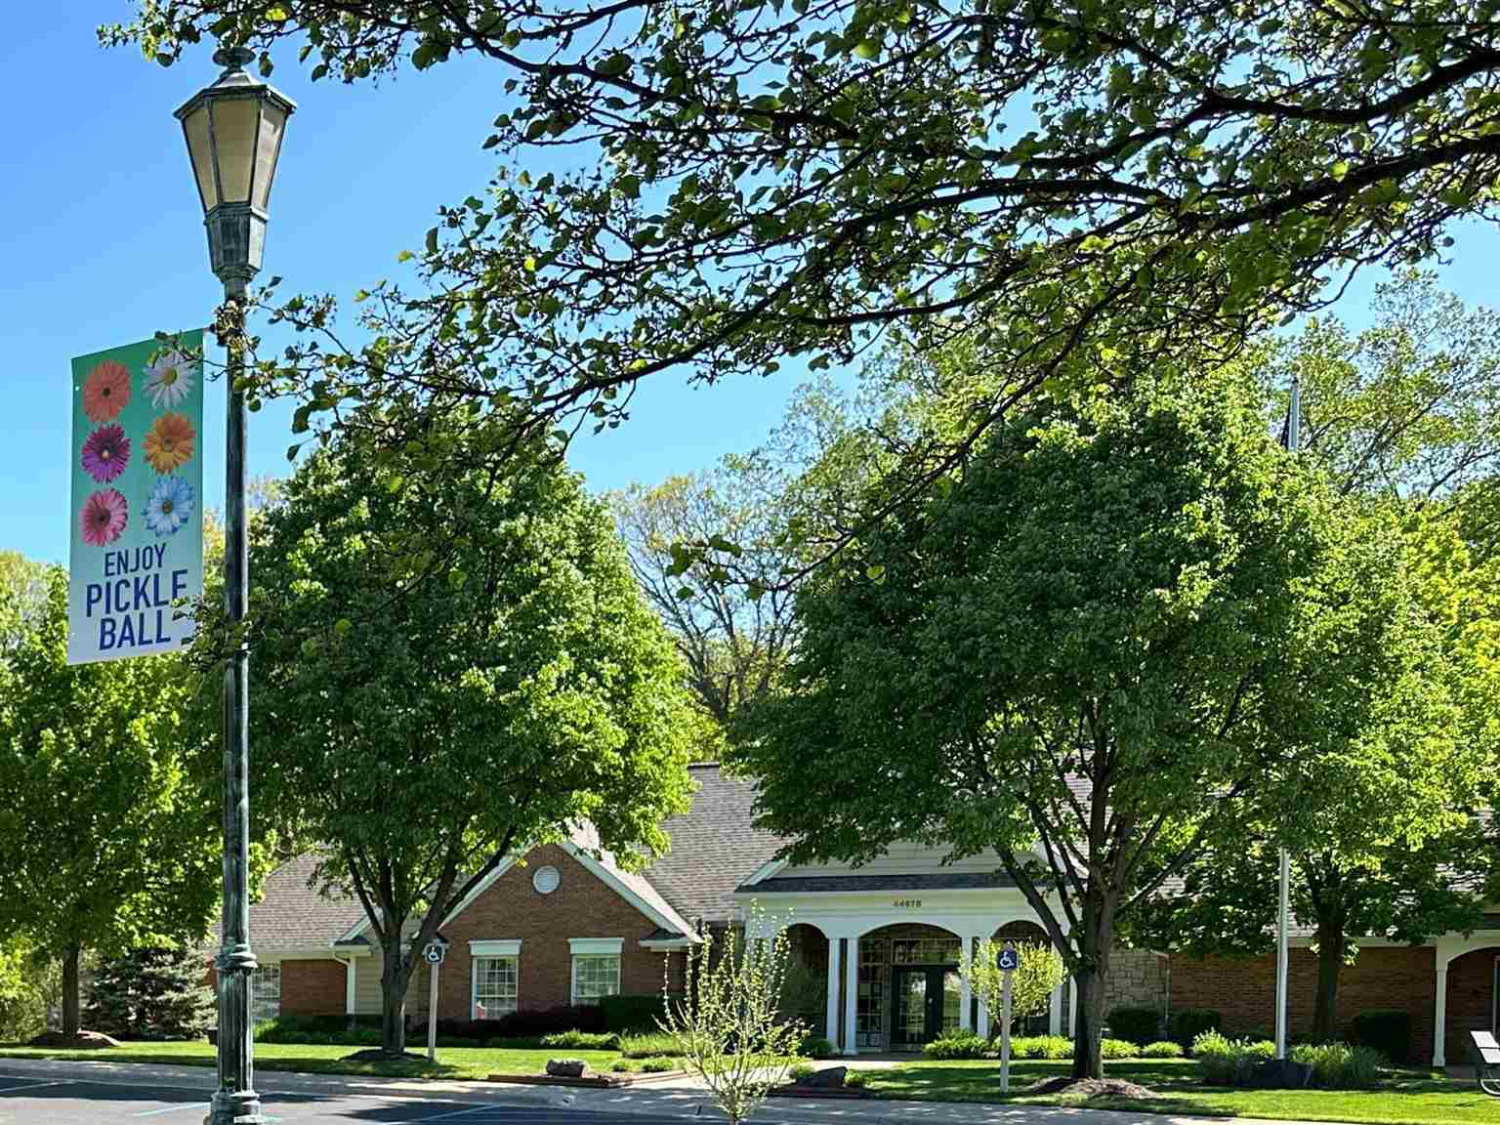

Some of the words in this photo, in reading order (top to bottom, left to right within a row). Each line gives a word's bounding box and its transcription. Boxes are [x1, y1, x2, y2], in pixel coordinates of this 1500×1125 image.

[105, 543, 166, 577] ENJOY
[86, 569, 188, 617] PICKLE
[100, 609, 171, 650] BALL
